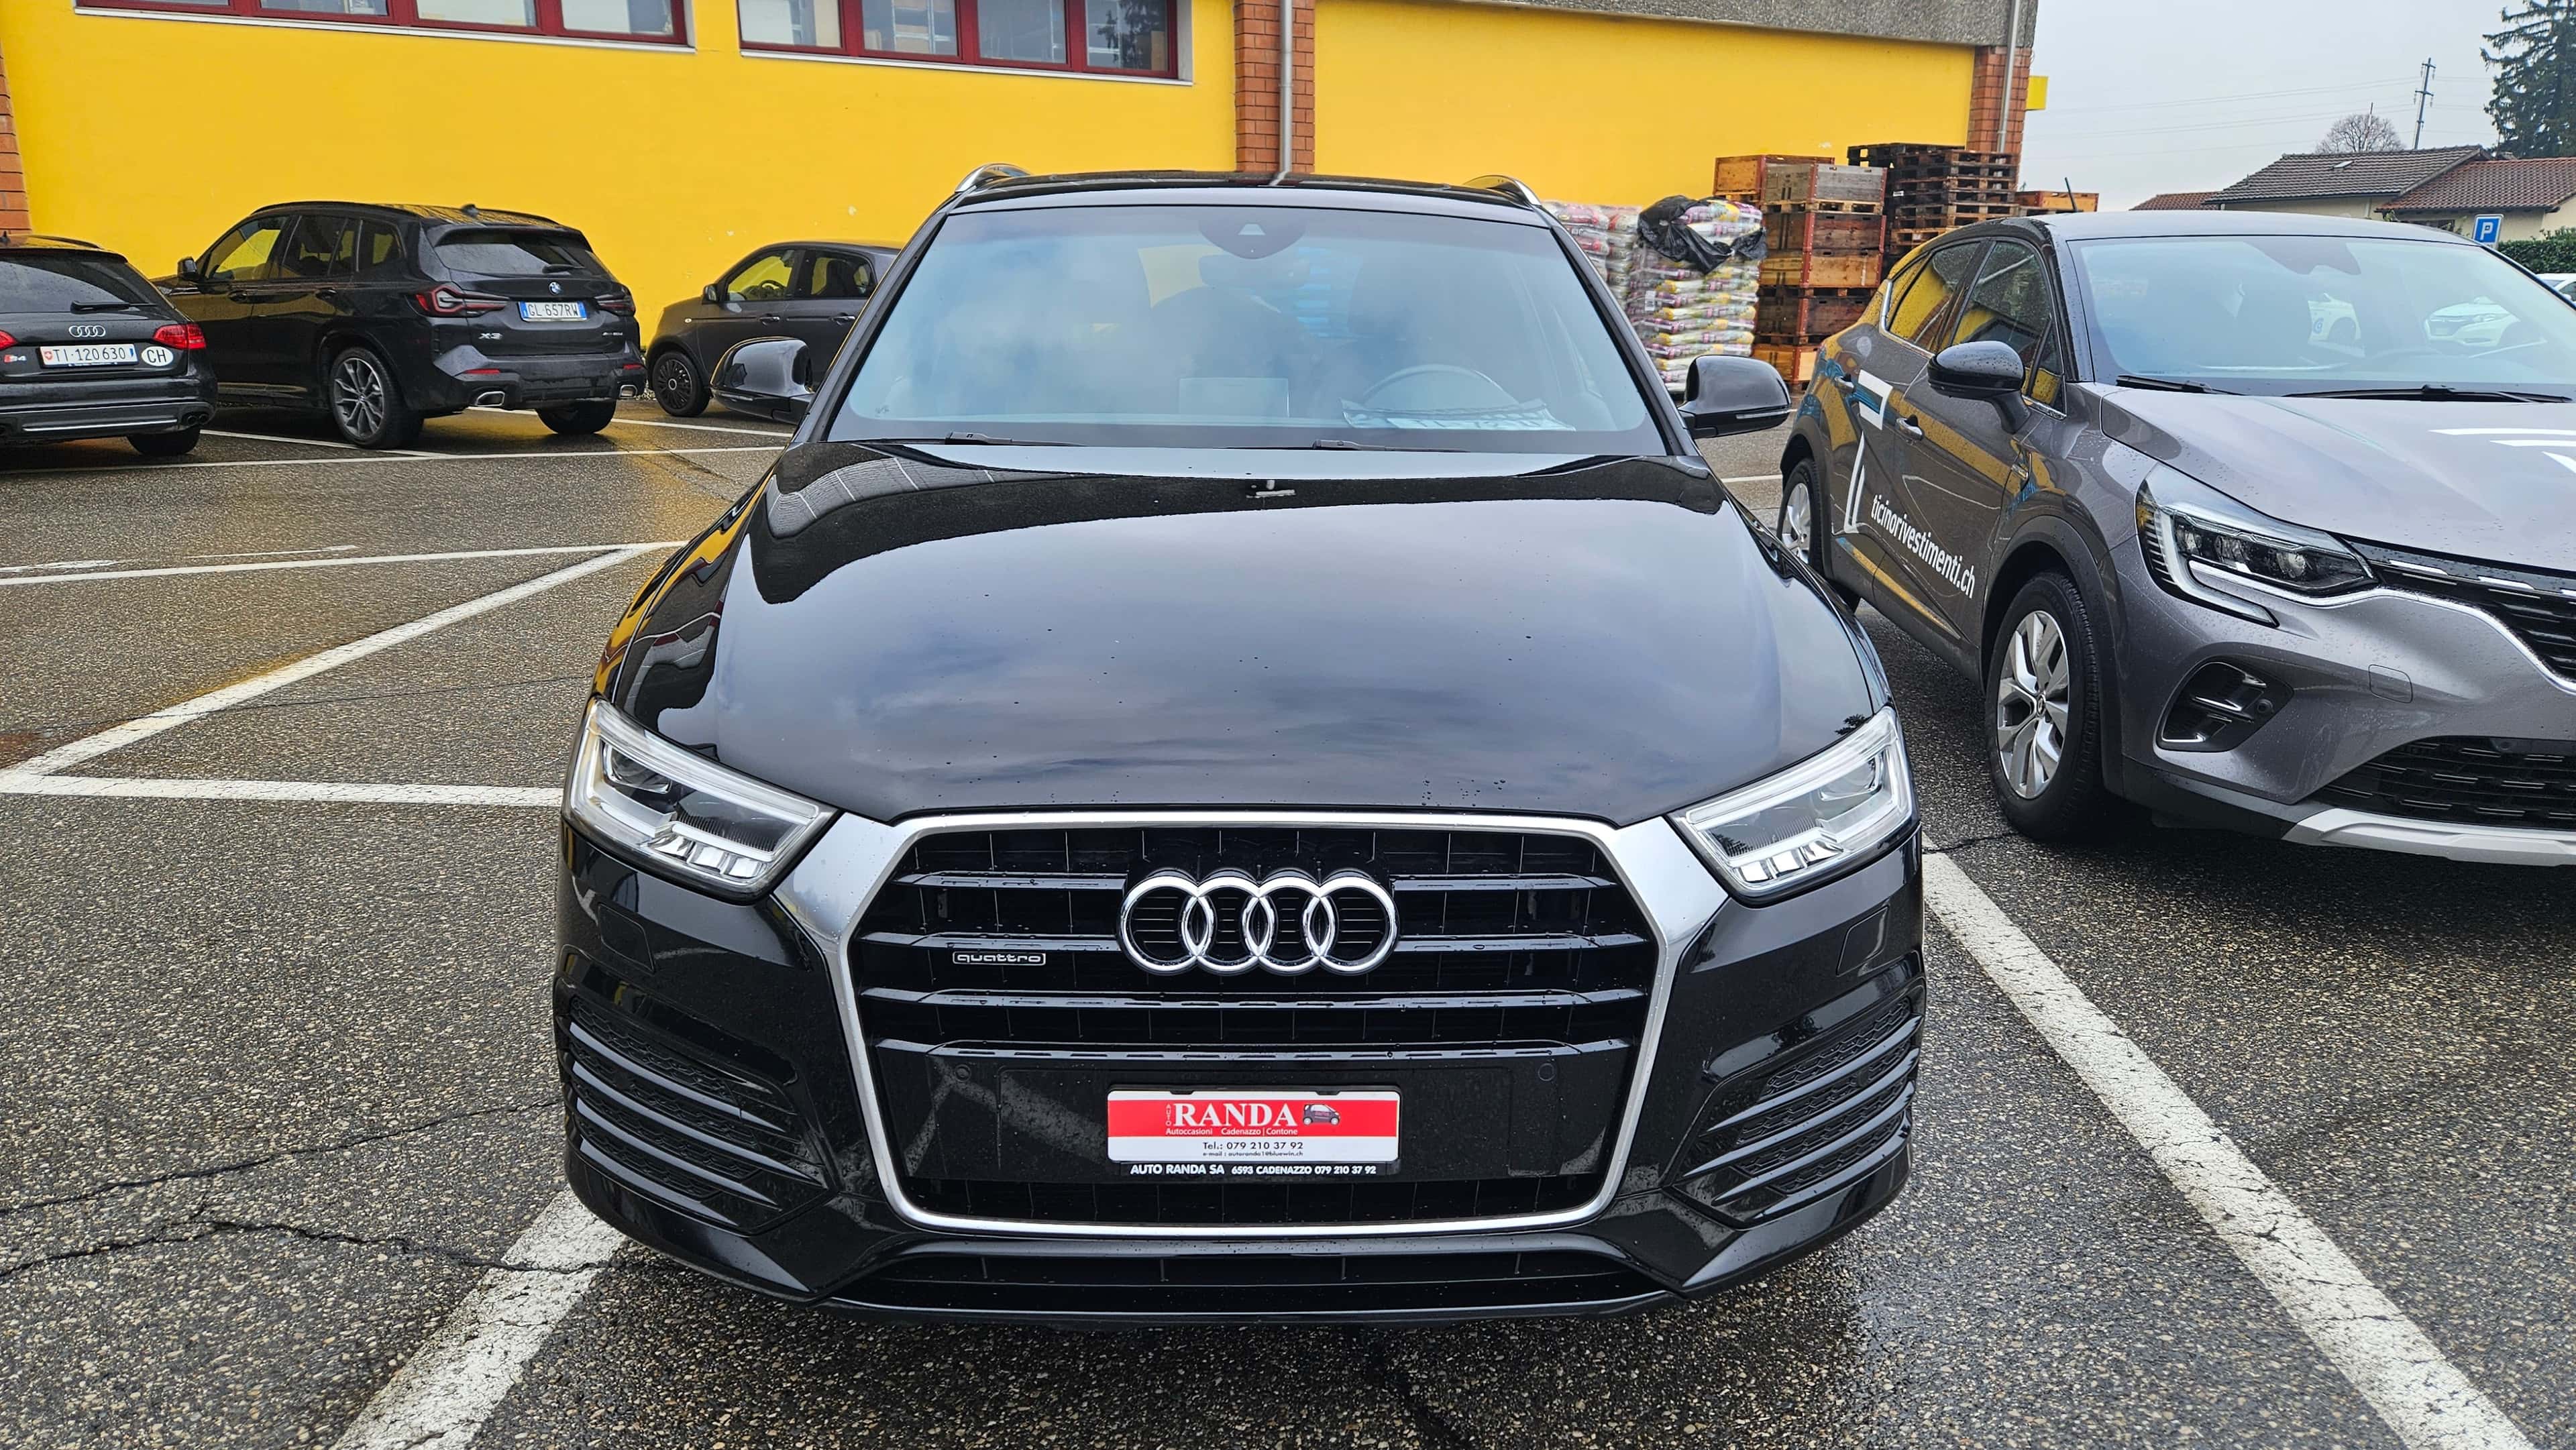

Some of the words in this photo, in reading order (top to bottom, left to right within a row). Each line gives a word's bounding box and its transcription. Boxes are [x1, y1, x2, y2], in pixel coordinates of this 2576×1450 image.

[2480, 222, 2493, 241] P
[544, 304, 578, 317] 657RW
[147, 349, 166, 363] CH
[1871, 494, 1976, 599] ticinorivestimenti.ch
[957, 954, 1041, 963] quattro
[1174, 1103, 1297, 1127] RANDA
[1203, 1141, 1223, 1150] Tel.:
[1226, 1141, 1246, 1150] 079
[1250, 1141, 1270, 1150] 210
[1274, 1141, 1287, 1150] 37
[1290, 1141, 1303, 1150] 92
[1130, 1164, 1163, 1174] AUTO
[1166, 1164, 1206, 1174] RANDA
[1210, 1164, 1224, 1174] SA
[1232, 1166, 1254, 1174] 6593
[1256, 1166, 1312, 1174] CADENAZZO
[1314, 1166, 1332, 1174] 079
[1334, 1166, 1350, 1174] 210
[1351, 1166, 1362, 1174] 37
[1364, 1166, 1377, 1174] 92
